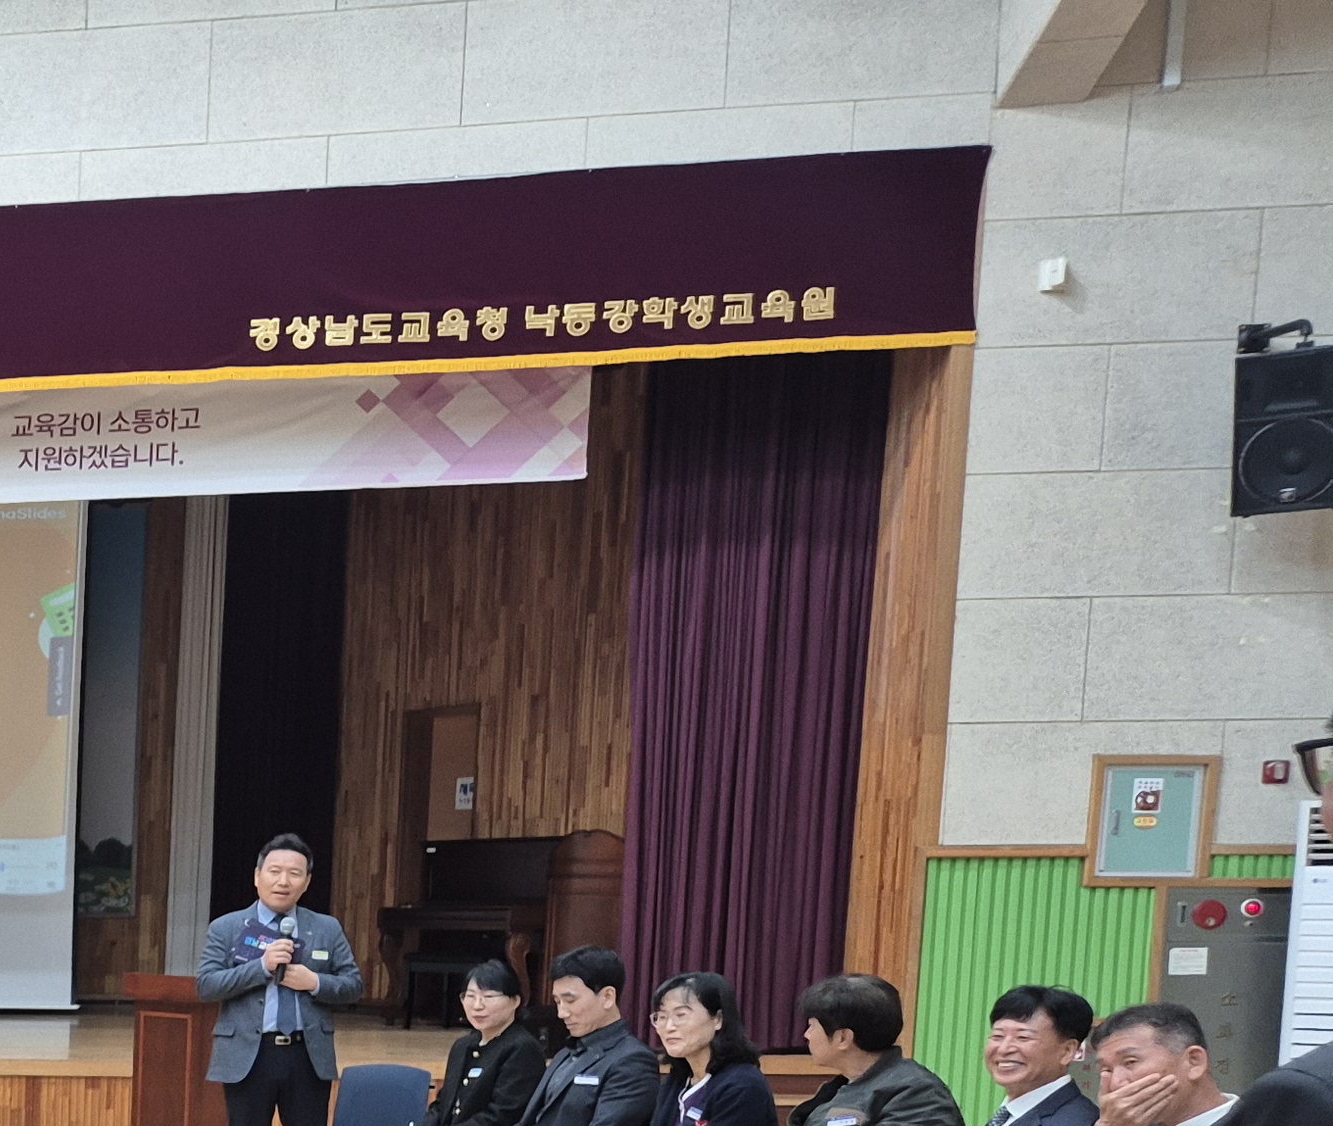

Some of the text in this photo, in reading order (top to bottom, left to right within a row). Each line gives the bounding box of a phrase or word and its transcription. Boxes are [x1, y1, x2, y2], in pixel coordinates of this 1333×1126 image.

[248, 286, 836, 352] 경상남도교육청 낙동강학생교육원
[11, 407, 201, 438] 교육감이 소통하고
[18, 441, 184, 472] 지원하겠습니다.
